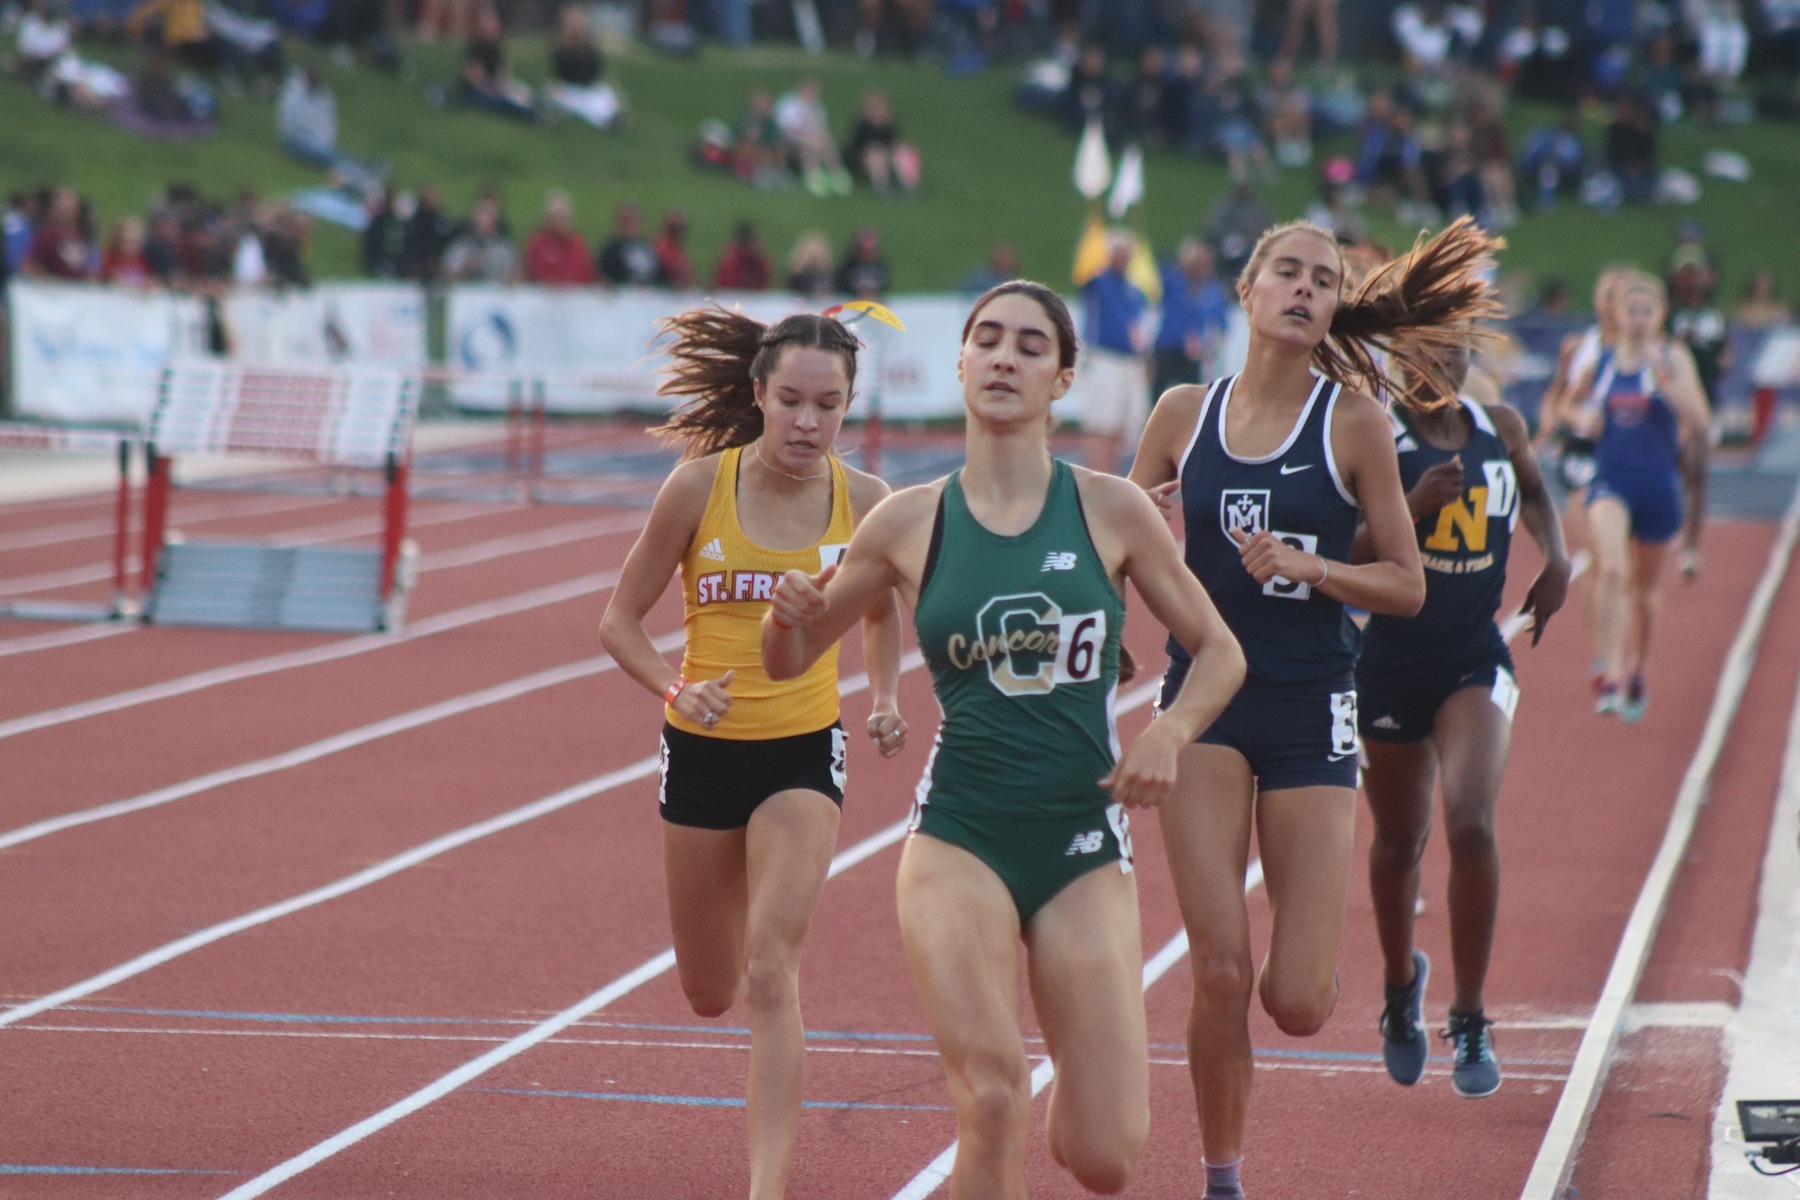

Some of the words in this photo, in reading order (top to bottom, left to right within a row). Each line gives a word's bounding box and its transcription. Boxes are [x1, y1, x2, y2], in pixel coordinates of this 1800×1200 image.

[1227, 505, 1262, 534] M
[1425, 486, 1488, 551] N
[699, 550, 725, 562] adidas
[698, 571, 729, 606] ST.
[947, 629, 1062, 671] Concor
[1067, 618, 1096, 680] 6
